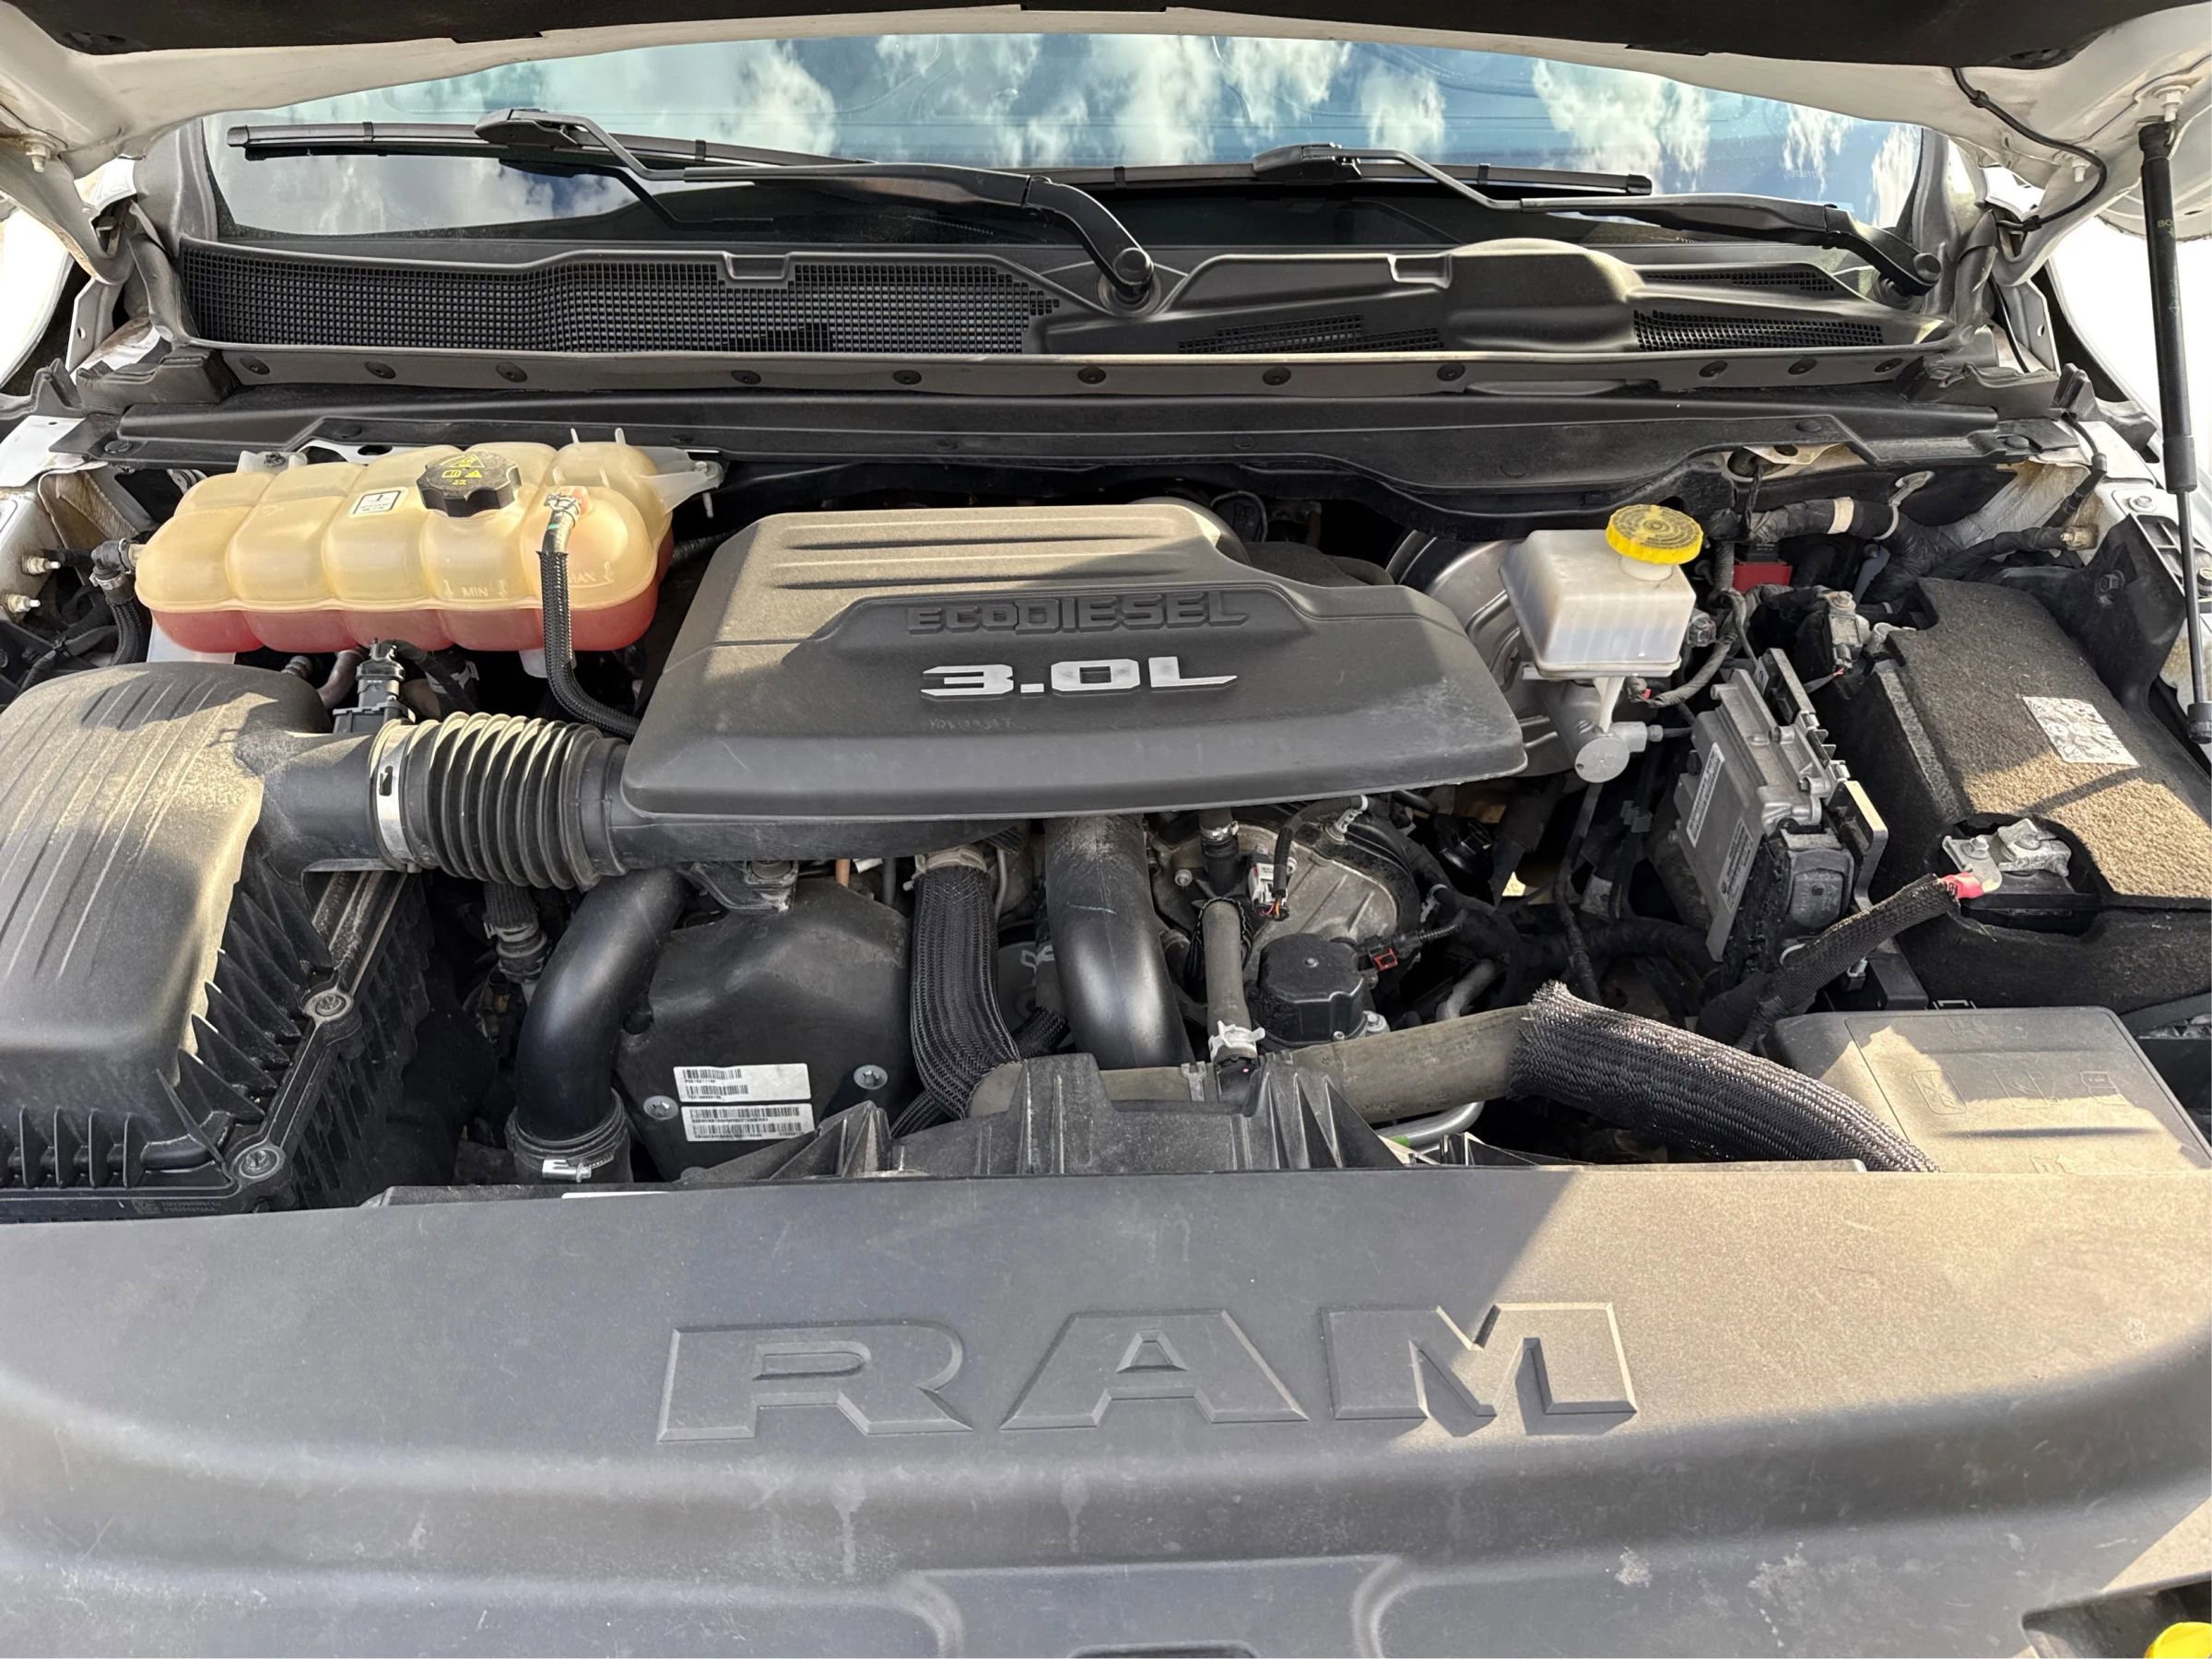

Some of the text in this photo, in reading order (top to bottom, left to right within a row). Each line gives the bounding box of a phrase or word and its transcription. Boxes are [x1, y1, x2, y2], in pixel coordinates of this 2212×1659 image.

[461, 585, 488, 598] MIN
[908, 591, 1248, 634] ECODIESEL
[921, 655, 1238, 698] 3.0L
[656, 1301, 1637, 1443] RAM
